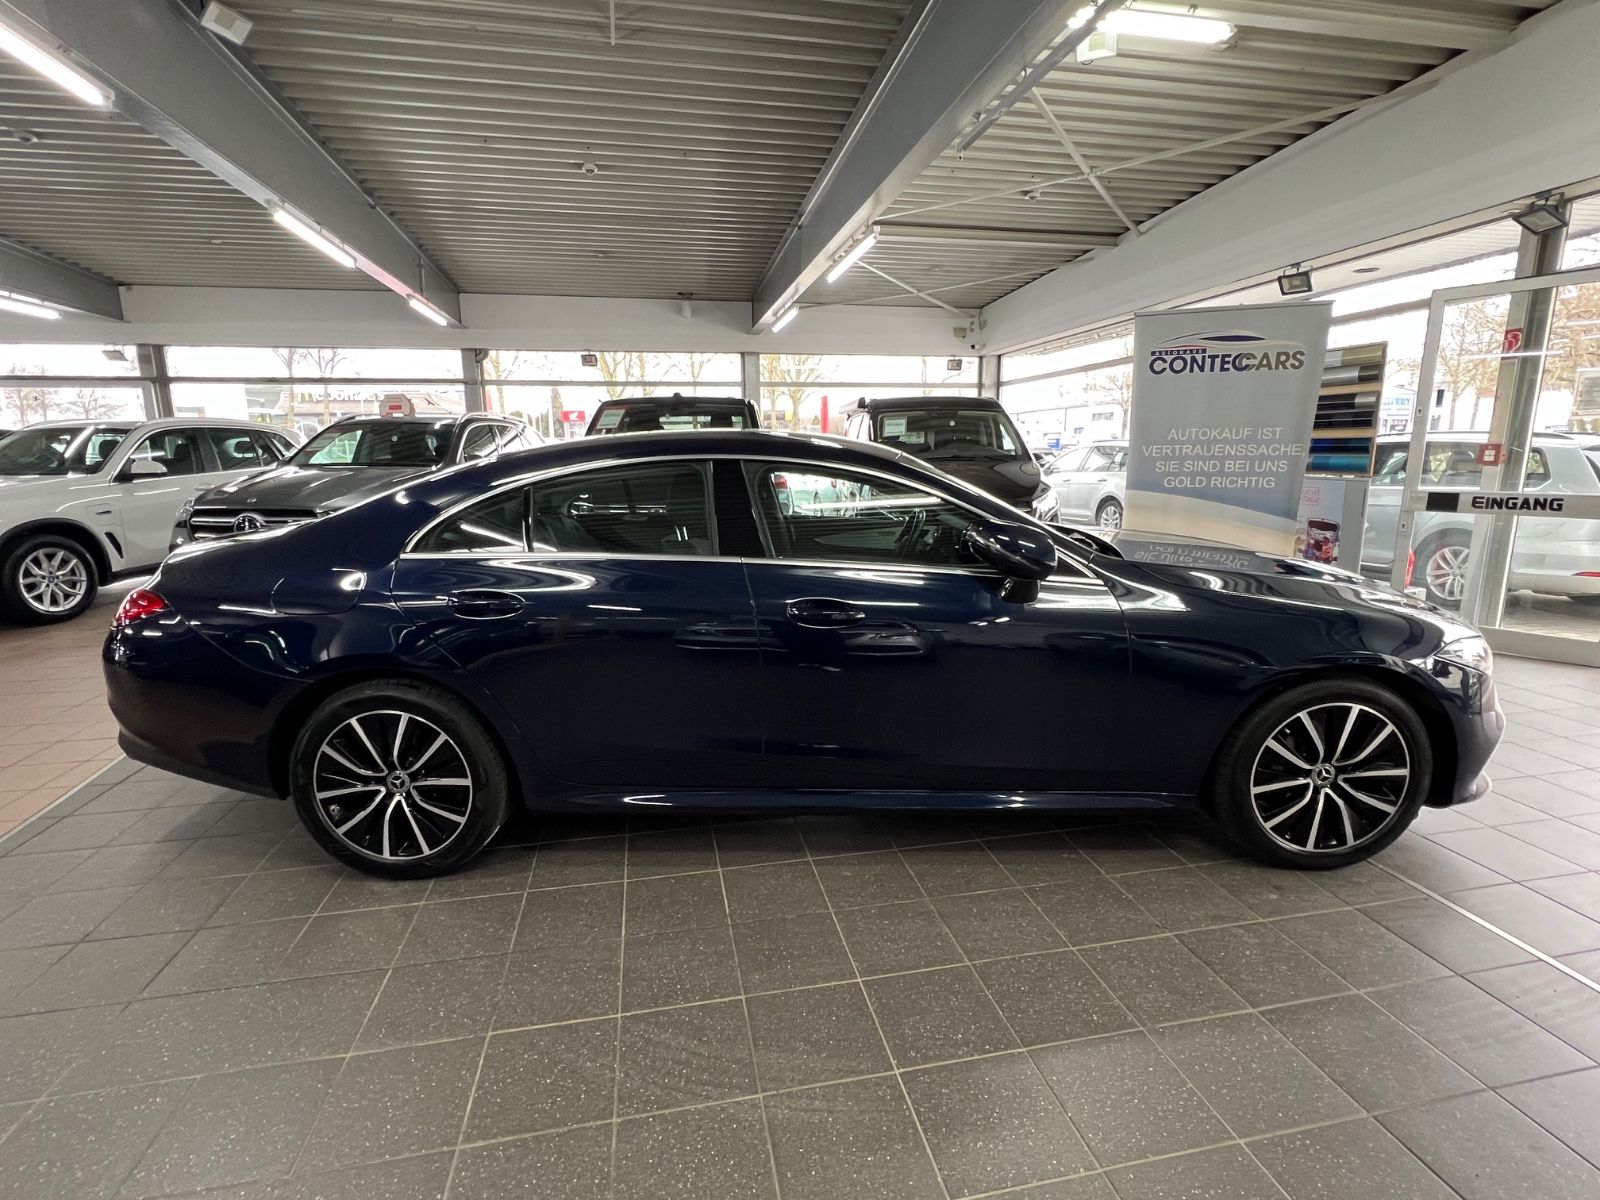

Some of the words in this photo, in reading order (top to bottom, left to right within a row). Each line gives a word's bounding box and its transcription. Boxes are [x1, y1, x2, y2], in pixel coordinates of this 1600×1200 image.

[1167, 427, 1254, 440] AUTOKAUF
[1257, 427, 1284, 440] IST
[1142, 444, 1306, 458] VERTRAUENSSACHE,
[1155, 461, 1180, 473] SIE
[1183, 460, 1220, 473] SIND
[1224, 460, 1250, 473] BEI
[1254, 460, 1288, 473] UNS
[1163, 476, 1206, 489] GOLD
[1210, 477, 1275, 489] RICHTIG
[1471, 496, 1565, 512] EINGANG
